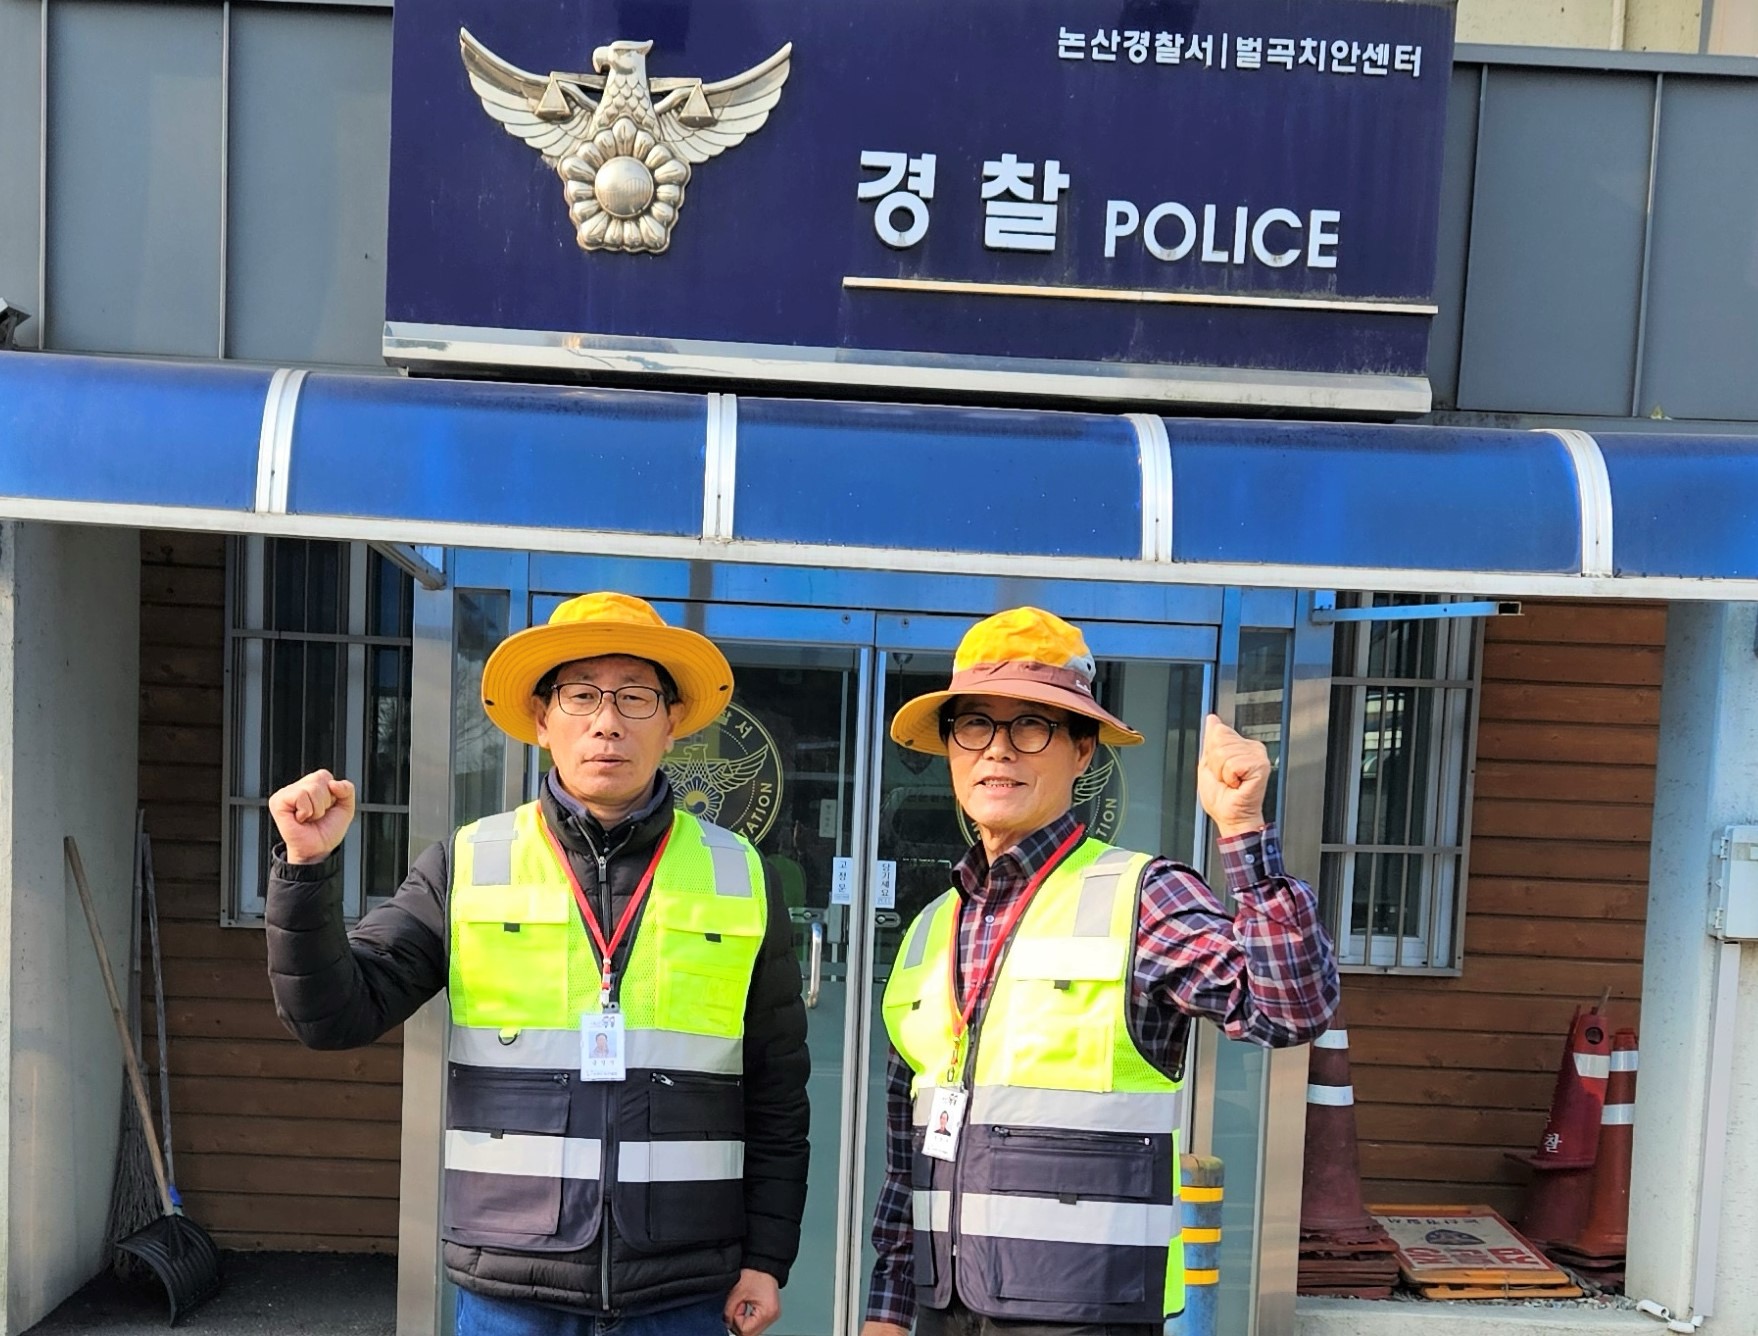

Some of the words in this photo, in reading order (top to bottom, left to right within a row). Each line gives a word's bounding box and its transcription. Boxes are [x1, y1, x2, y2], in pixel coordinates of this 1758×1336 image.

[1058, 26, 1213, 66] 논산경찰서
[1236, 36, 1422, 77] 벌곡치안센터
[857, 150, 1071, 252] 경찰
[1104, 200, 1341, 268] POLICE
